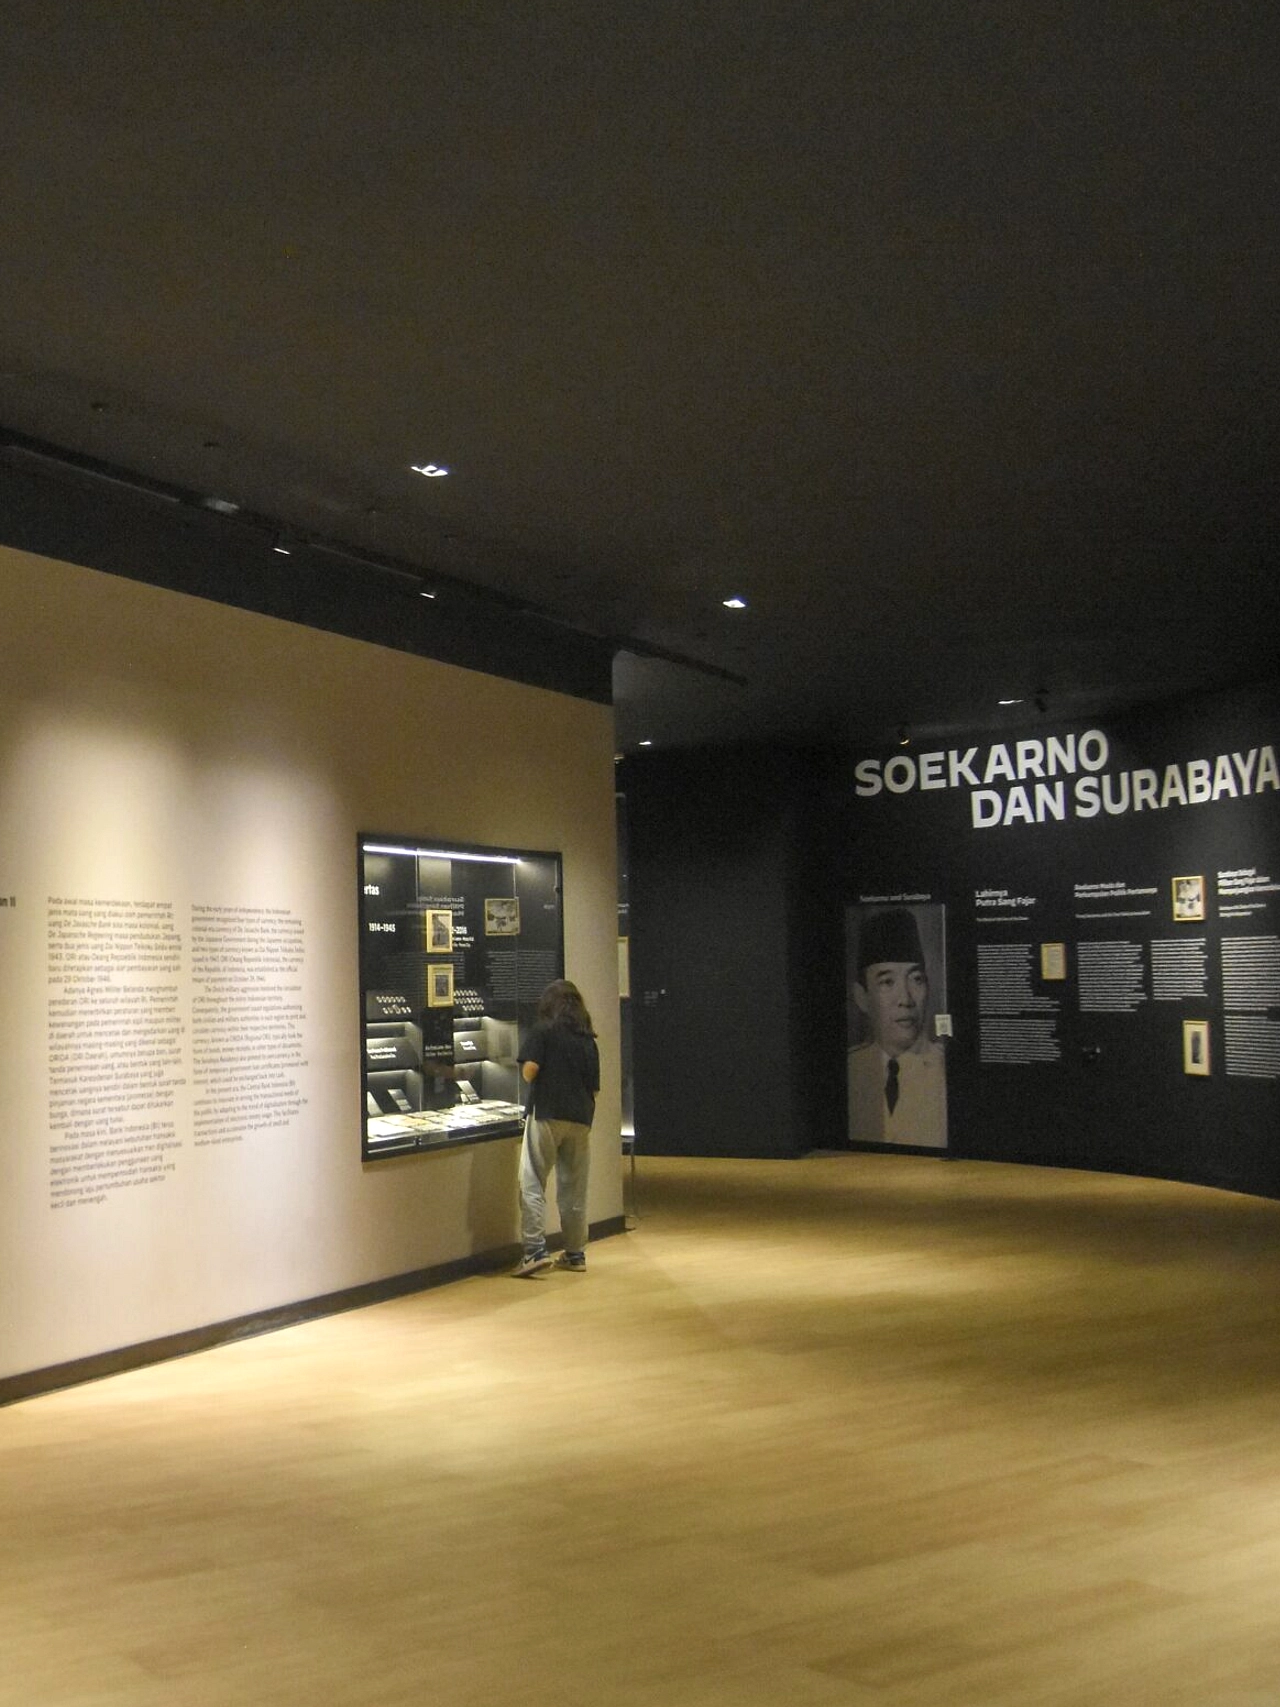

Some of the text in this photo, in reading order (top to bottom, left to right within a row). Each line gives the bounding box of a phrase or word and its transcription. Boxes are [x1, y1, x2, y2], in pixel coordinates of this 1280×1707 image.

[855, 729, 1109, 796] SOEKARNO
[971, 745, 1280, 828] DAN SURABAYA
[364, 884, 380, 895] rtas
[976, 898, 997, 907] Putra
[997, 898, 1016, 908] Sang
